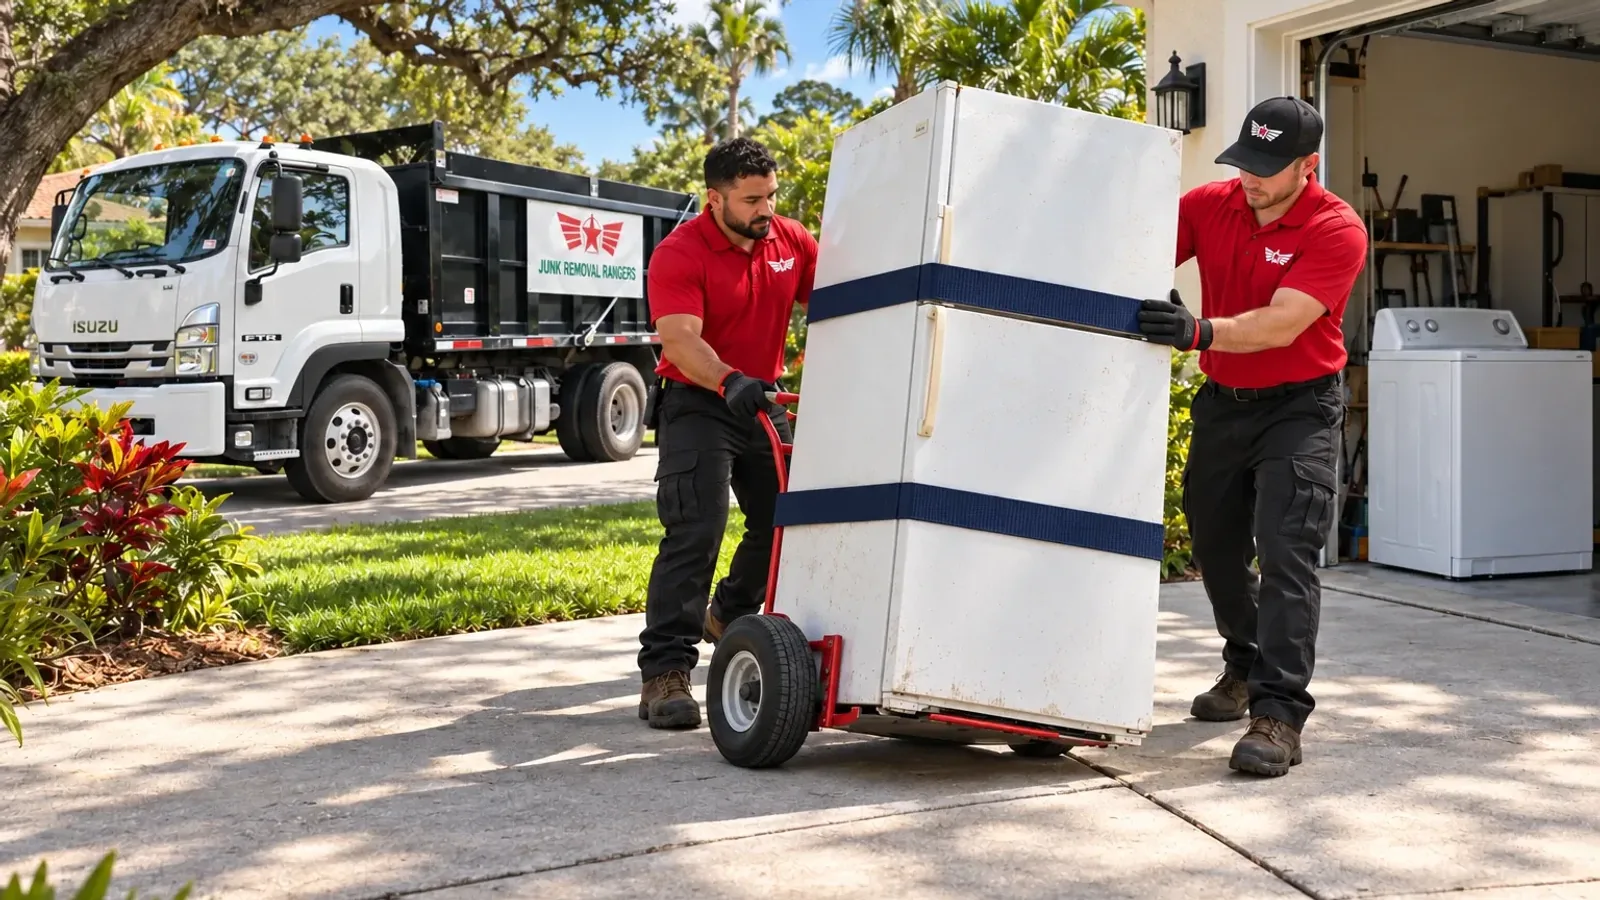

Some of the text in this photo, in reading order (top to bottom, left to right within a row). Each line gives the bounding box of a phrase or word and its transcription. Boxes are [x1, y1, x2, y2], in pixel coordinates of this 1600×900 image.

[538, 259, 636, 280] JUNK REMOVAL RANGERS
[72, 320, 118, 333] ISUZU
[245, 334, 277, 342] FTR
